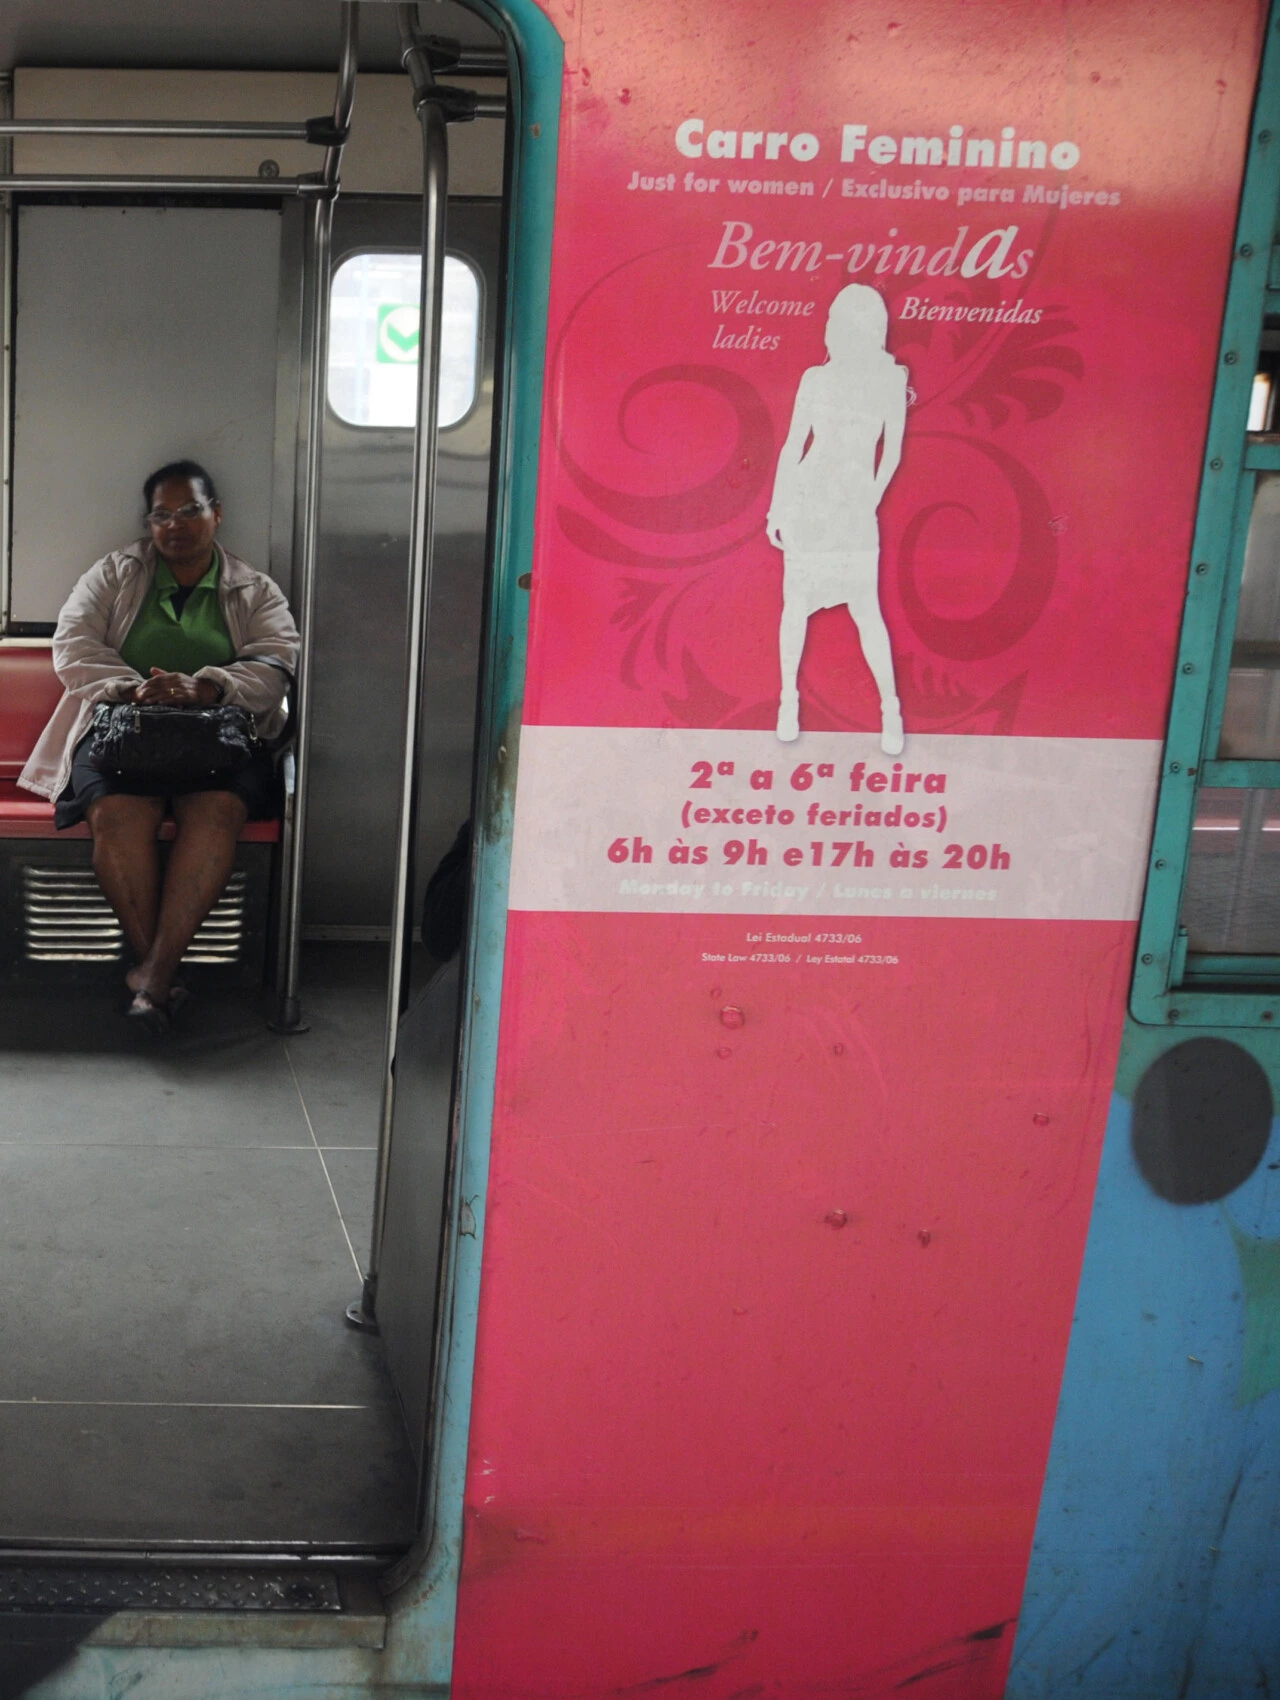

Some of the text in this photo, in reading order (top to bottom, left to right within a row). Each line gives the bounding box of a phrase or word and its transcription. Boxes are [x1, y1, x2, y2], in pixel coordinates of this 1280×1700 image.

[675, 118, 1080, 171] Carro Feminino
[628, 172, 676, 192] Just
[684, 172, 719, 193] for
[728, 179, 814, 196] women
[842, 179, 949, 201] Exclusivo
[958, 185, 1015, 206] para
[1022, 184, 1121, 210] Mujeres
[707, 220, 1035, 280] Bem-vindas
[710, 290, 815, 318] Welcome
[899, 297, 1043, 325] Bienvenidas
[712, 325, 780, 352] ladies
[750, 768, 773, 790] a
[849, 762, 947, 794] feira
[681, 800, 947, 833] (exceto feriados)
[607, 837, 653, 864] 6h
[668, 838, 708, 865] às
[723, 839, 768, 866] 9h
[889, 842, 928, 869] às
[942, 843, 1010, 870] 20h
[618, 879, 704, 899] Monday
[712, 882, 734, 896] to
[740, 881, 810, 902] Friday
[833, 883, 892, 900] Lunes
[900, 887, 912, 900] a
[919, 884, 998, 901] viernes
[746, 932, 862, 944] Lei Estadual 4733/06
[701, 952, 726, 963] State
[727, 953, 747, 963] Law
[749, 953, 791, 964] 4733/06
[806, 955, 822, 965] Ley
[824, 955, 855, 965] Estatal
[857, 955, 899, 965] 4733/06
